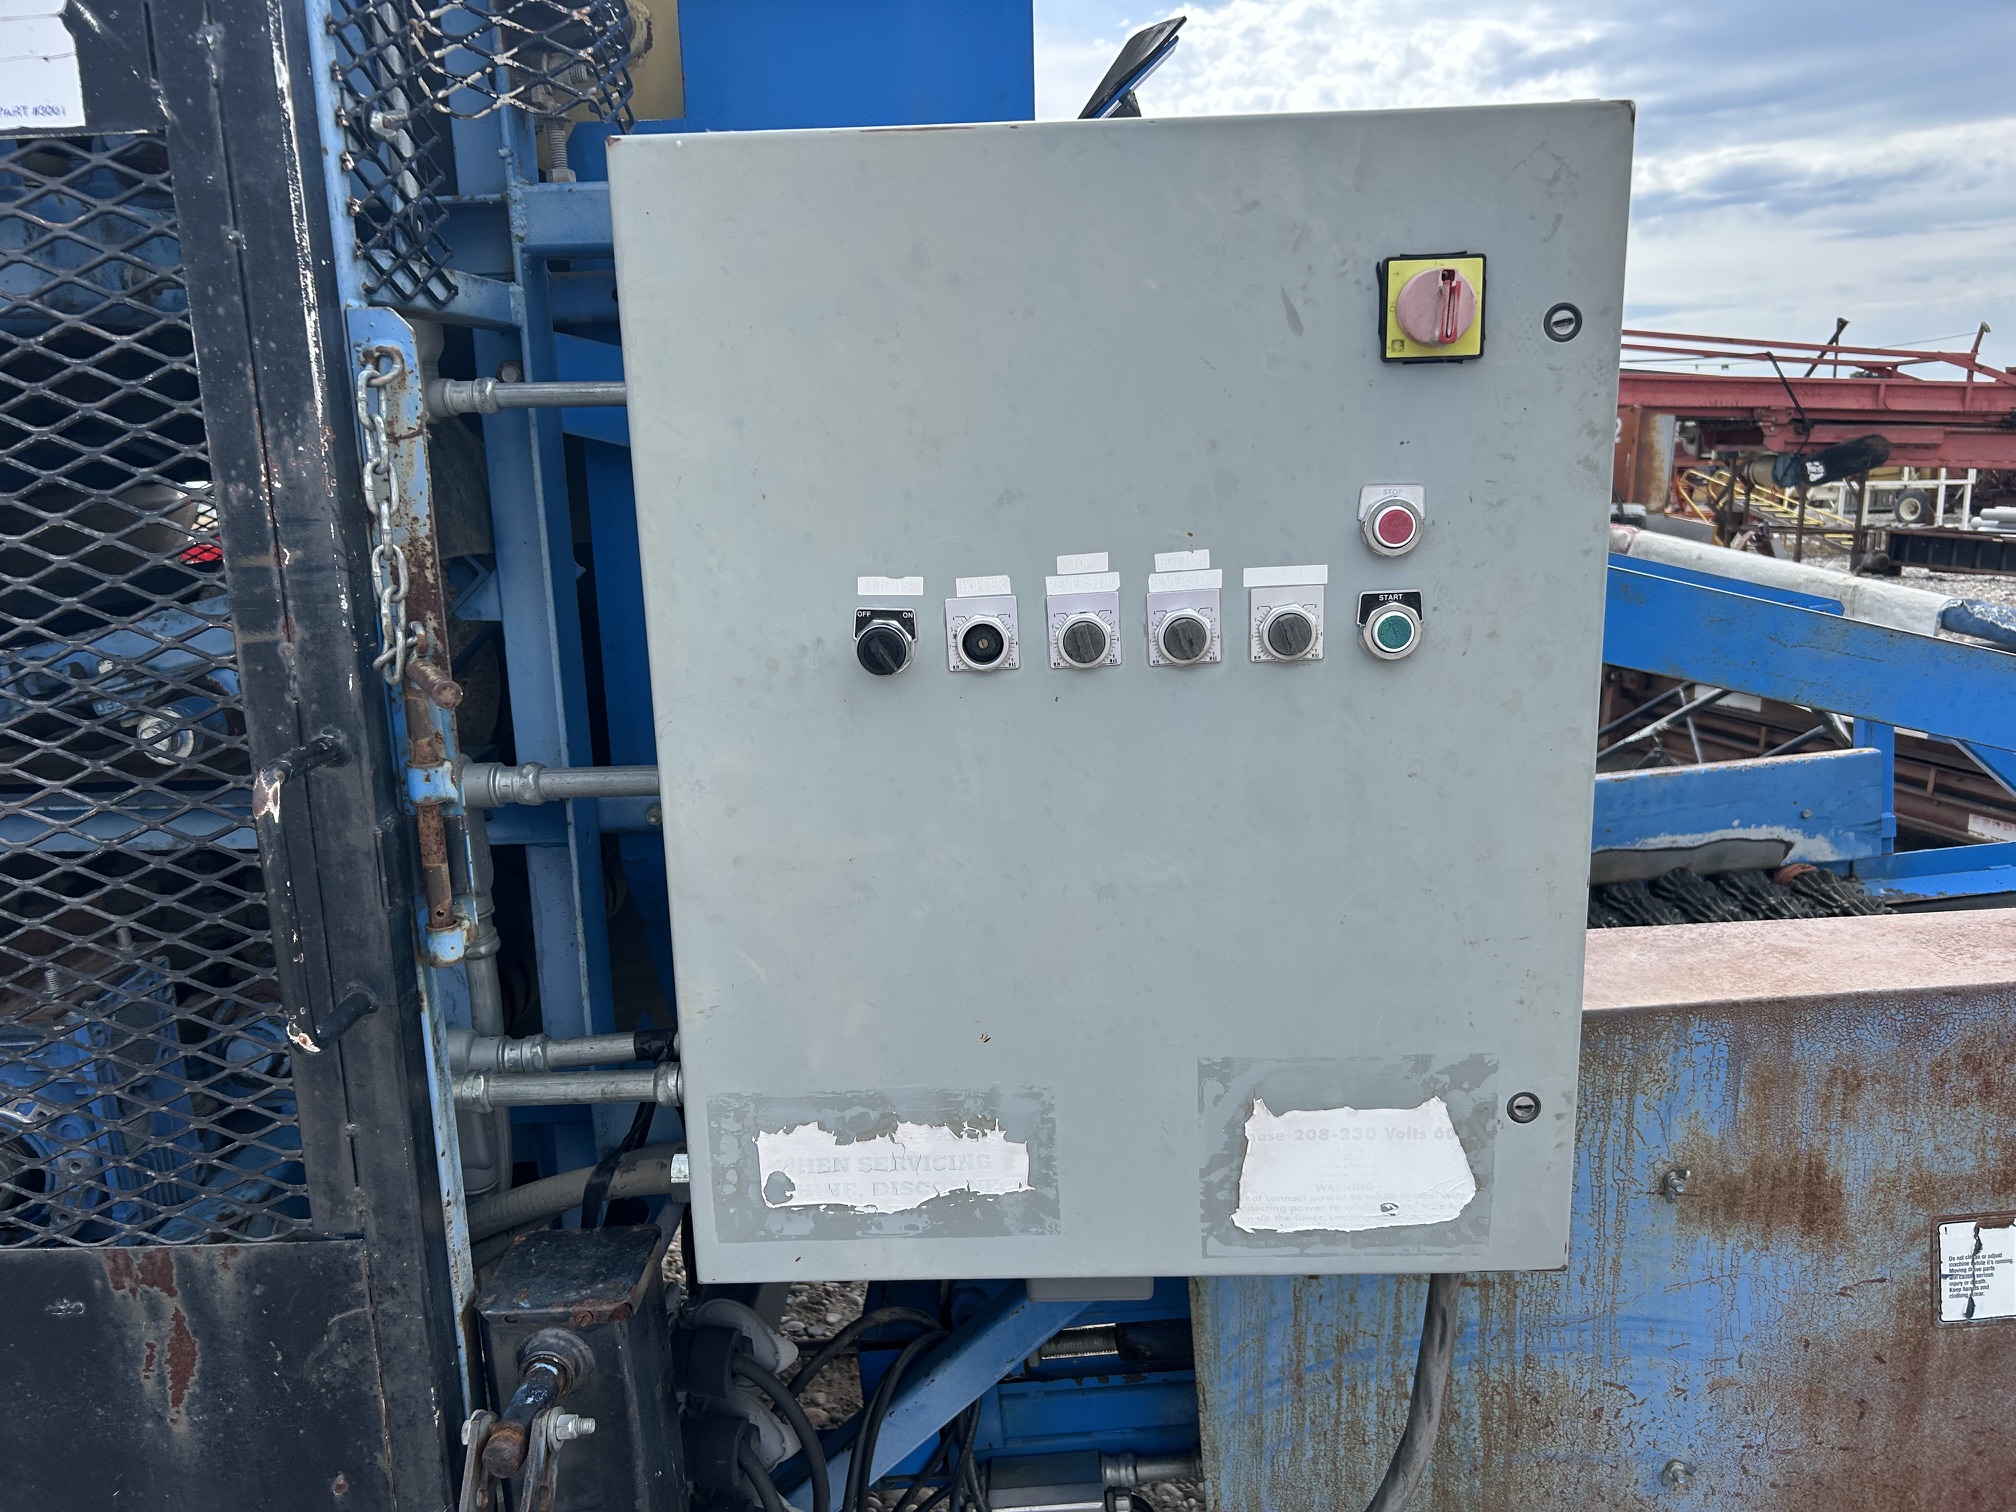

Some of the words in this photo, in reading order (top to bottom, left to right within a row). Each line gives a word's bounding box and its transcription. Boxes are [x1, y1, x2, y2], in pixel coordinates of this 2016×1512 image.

[1383, 488, 1403, 496] STOP
[1070, 557, 1092, 569] TOP
[1158, 554, 1204, 568] BOTTOM
[870, 579, 910, 591] LIGHTS
[960, 578, 1005, 592] HOPPER
[1049, 575, 1119, 591] REVERSING
[1151, 572, 1220, 588] REVERSING
[857, 610, 871, 618] OFF
[1293, 1125, 1377, 1141] 208-230
[1383, 1125, 1428, 1140] Volts
[857, 1153, 992, 1173] SERVICING
[1315, 1182, 1375, 1193] WARNING
[1264, 1193, 1306, 1203] connect
[1310, 1193, 1348, 1203] power
[1289, 1203, 1326, 1214] power
[1329, 1203, 1341, 1212] to
[1274, 1213, 1292, 1222] the
